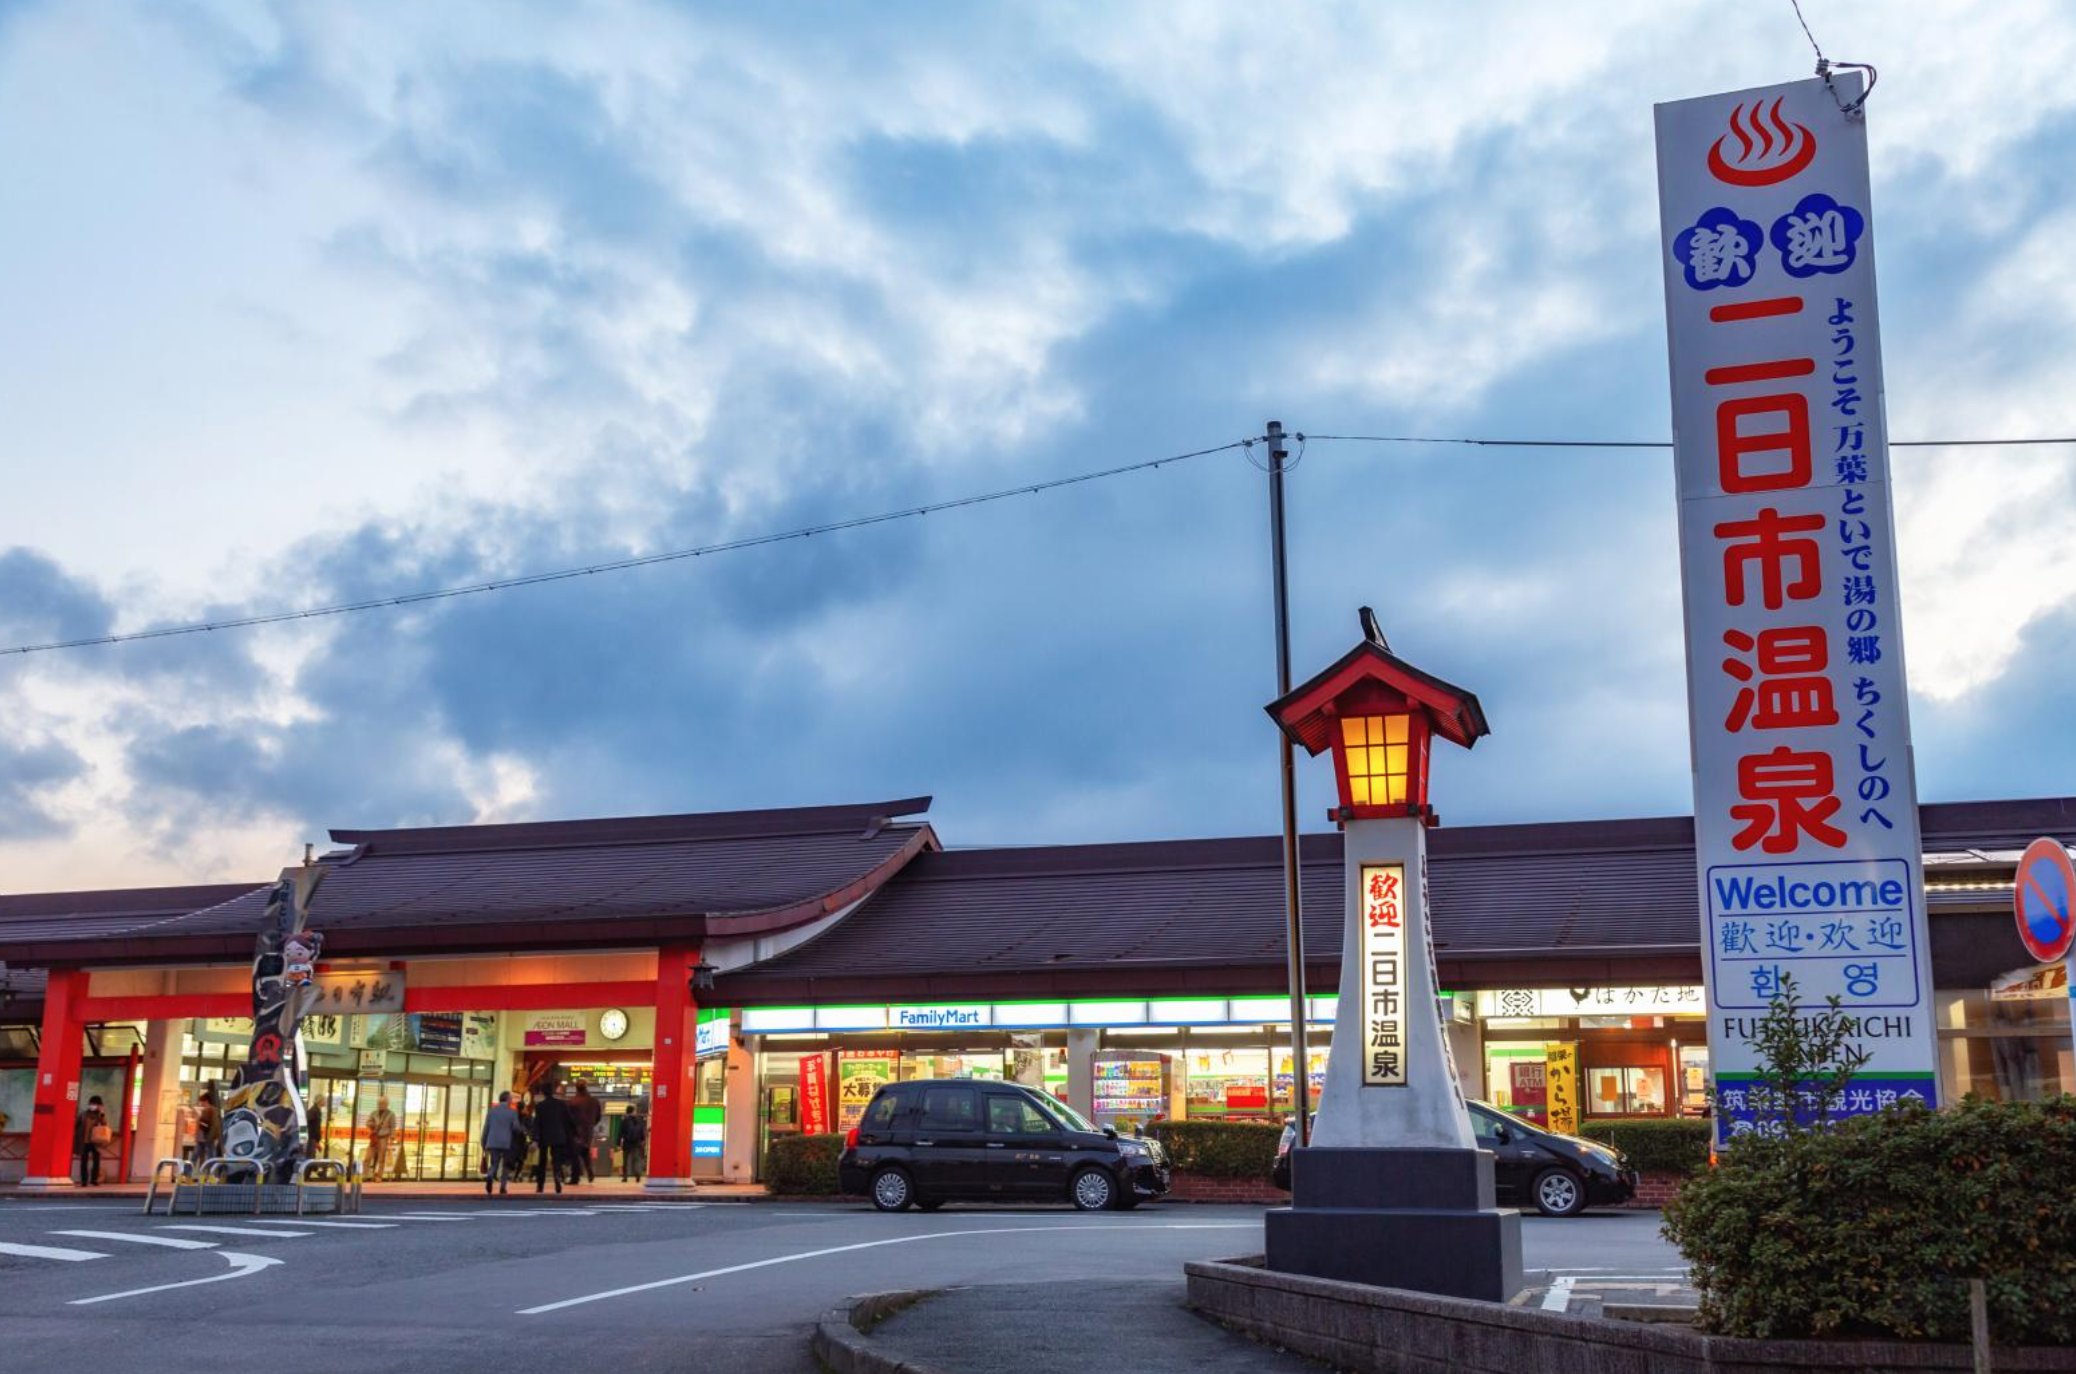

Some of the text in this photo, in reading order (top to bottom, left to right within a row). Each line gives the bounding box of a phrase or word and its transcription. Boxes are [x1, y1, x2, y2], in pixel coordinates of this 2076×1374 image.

[1704, 296, 1848, 855] 二日市温泉
[1715, 876, 1904, 911] Welcome
[900, 1009, 979, 1026] FamilyMart
[1519, 1078, 1543, 1088] ATM
